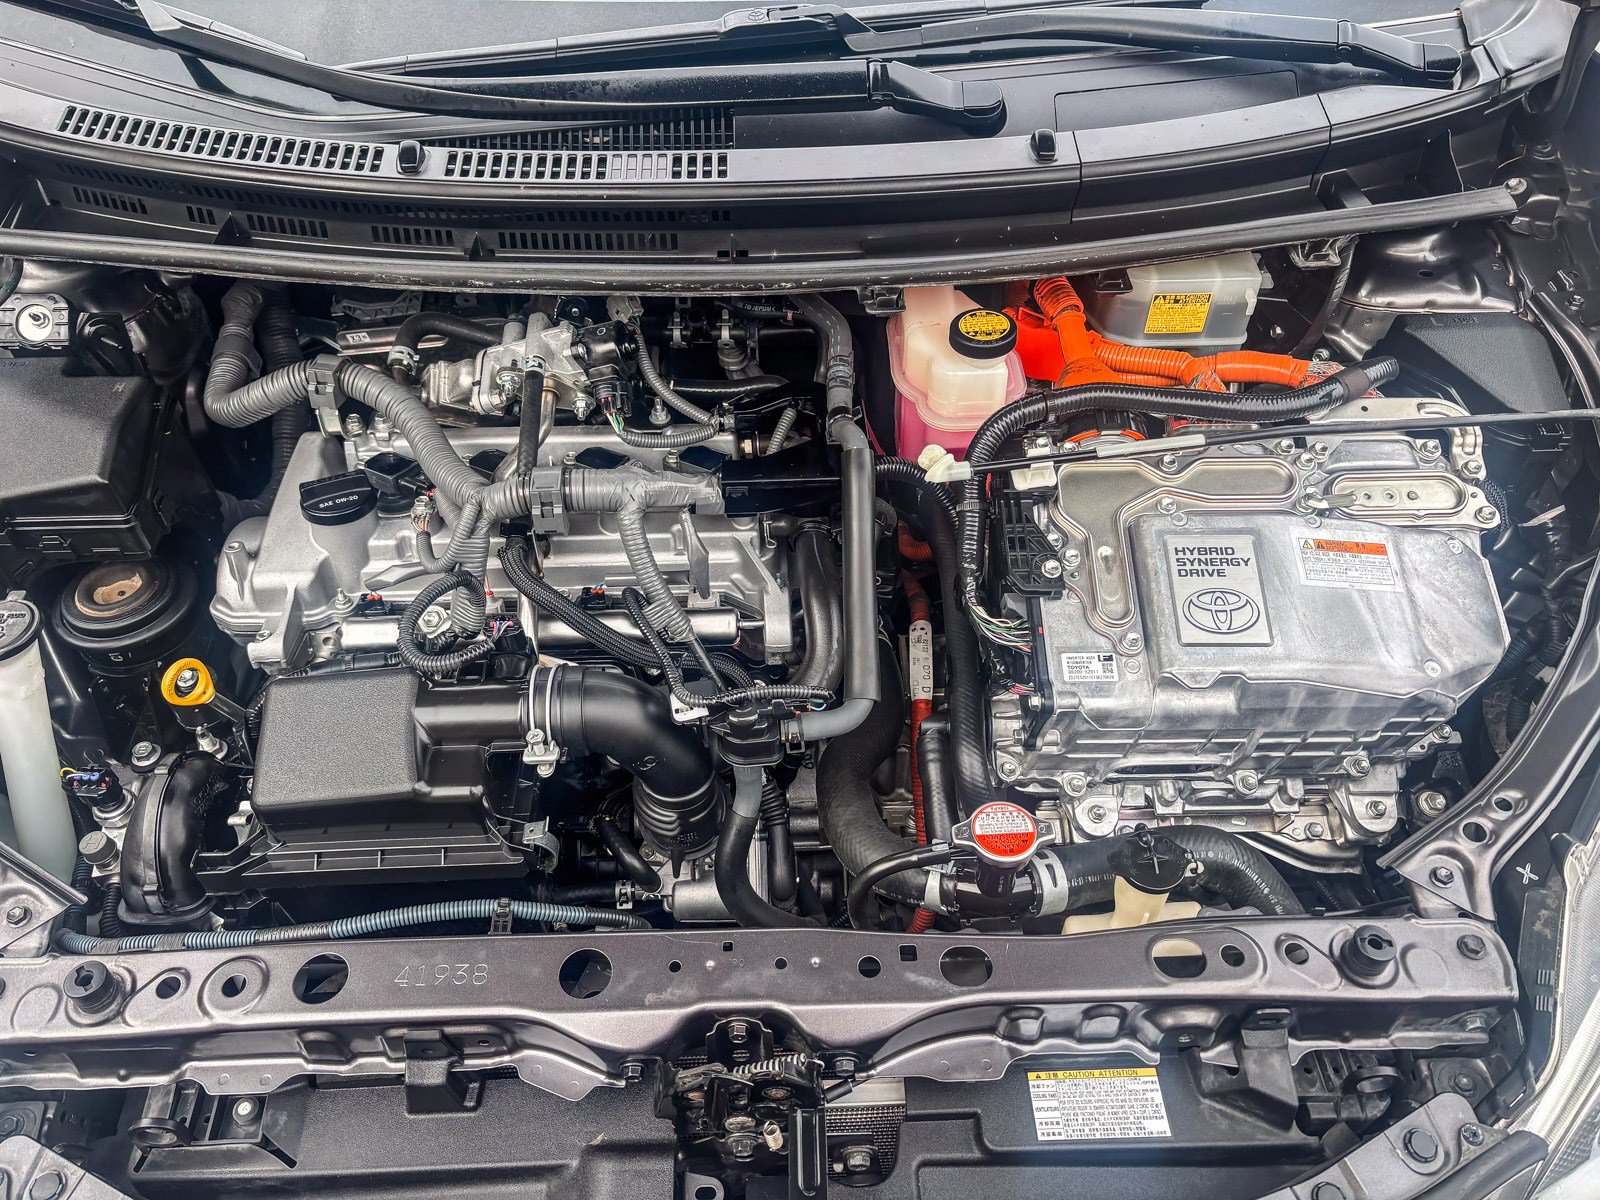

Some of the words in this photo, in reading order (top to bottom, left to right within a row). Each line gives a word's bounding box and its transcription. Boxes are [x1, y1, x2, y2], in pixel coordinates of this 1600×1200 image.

[319, 500, 333, 508] SAE
[335, 495, 359, 503] 0W-20
[1174, 546, 1235, 556] HYBRID
[1175, 557, 1251, 567] SYNERGY
[1177, 568, 1227, 578] DRIVE
[922, 664, 931, 680] 070
[394, 964, 489, 986] 41938
[1099, 1069, 1138, 1077] ATTENTION
